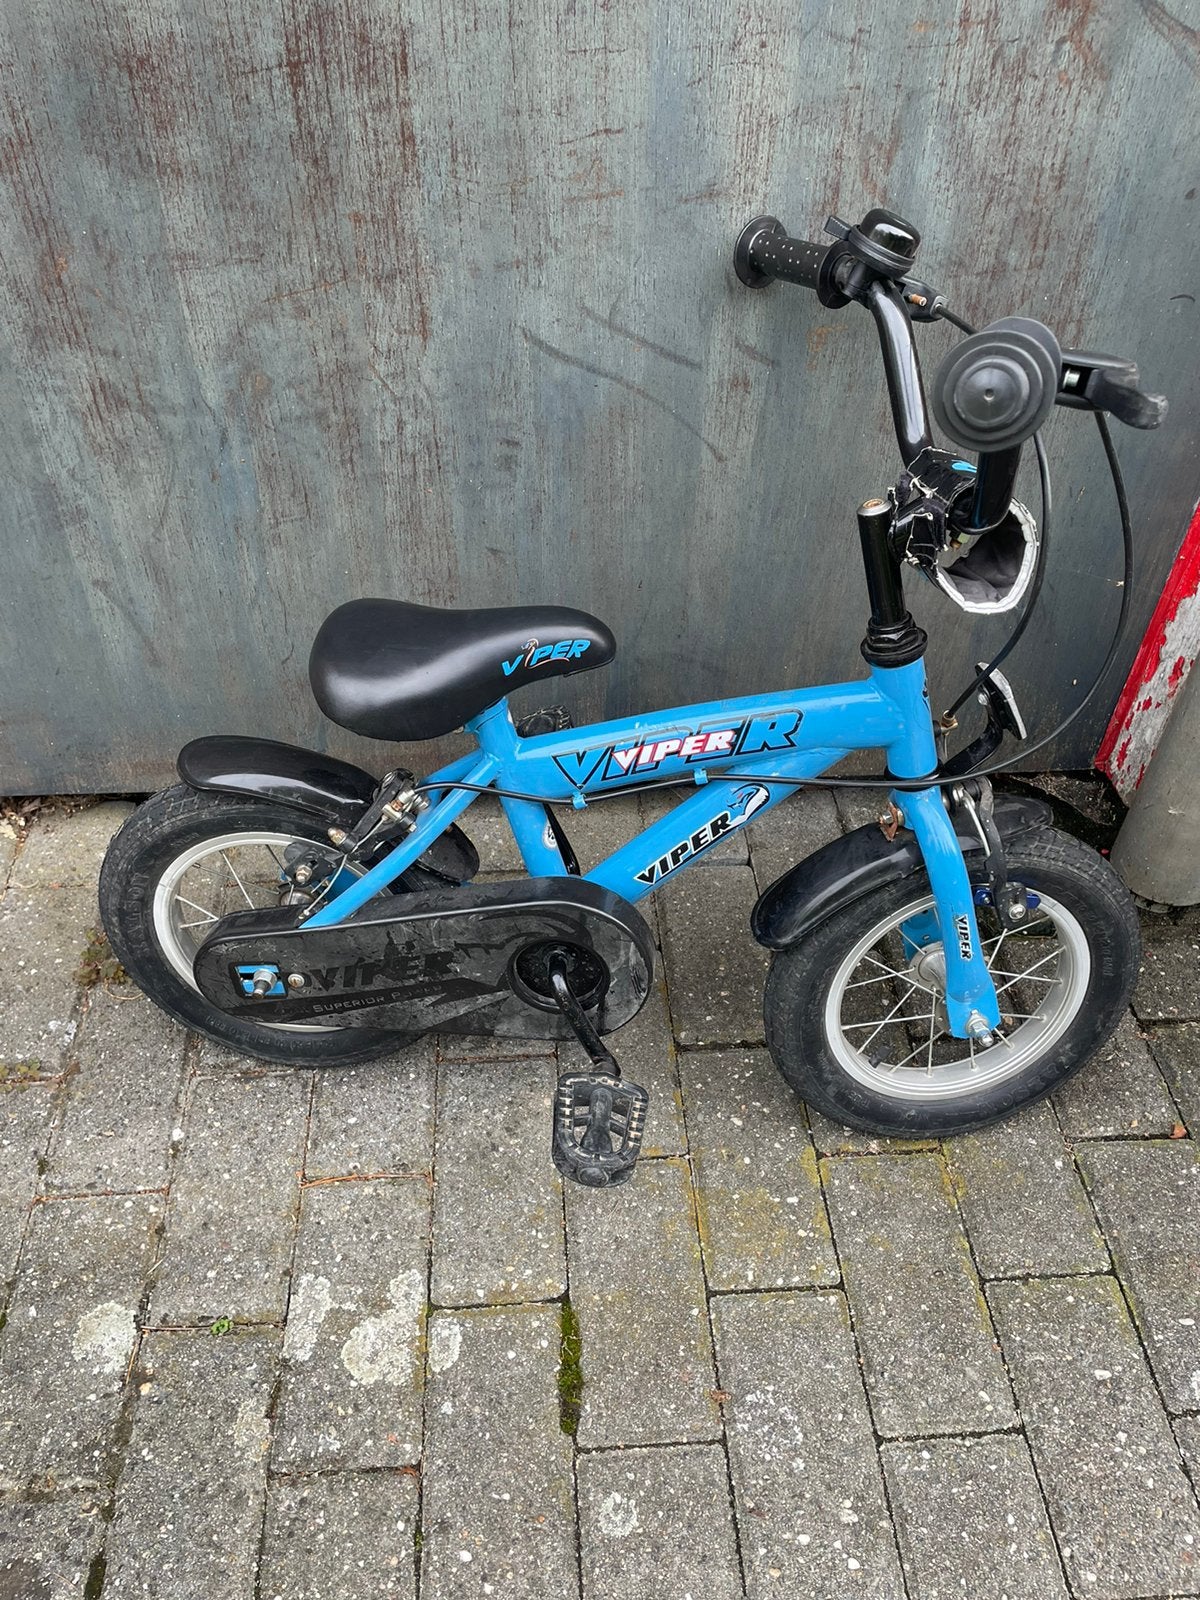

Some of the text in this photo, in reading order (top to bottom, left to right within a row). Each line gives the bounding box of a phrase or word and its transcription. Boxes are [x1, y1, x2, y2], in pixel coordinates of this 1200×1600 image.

[501, 638, 591, 676] VIPER
[611, 729, 736, 772] VIPER
[634, 811, 732, 885] VIPER
[956, 914, 972, 961] VIPER
